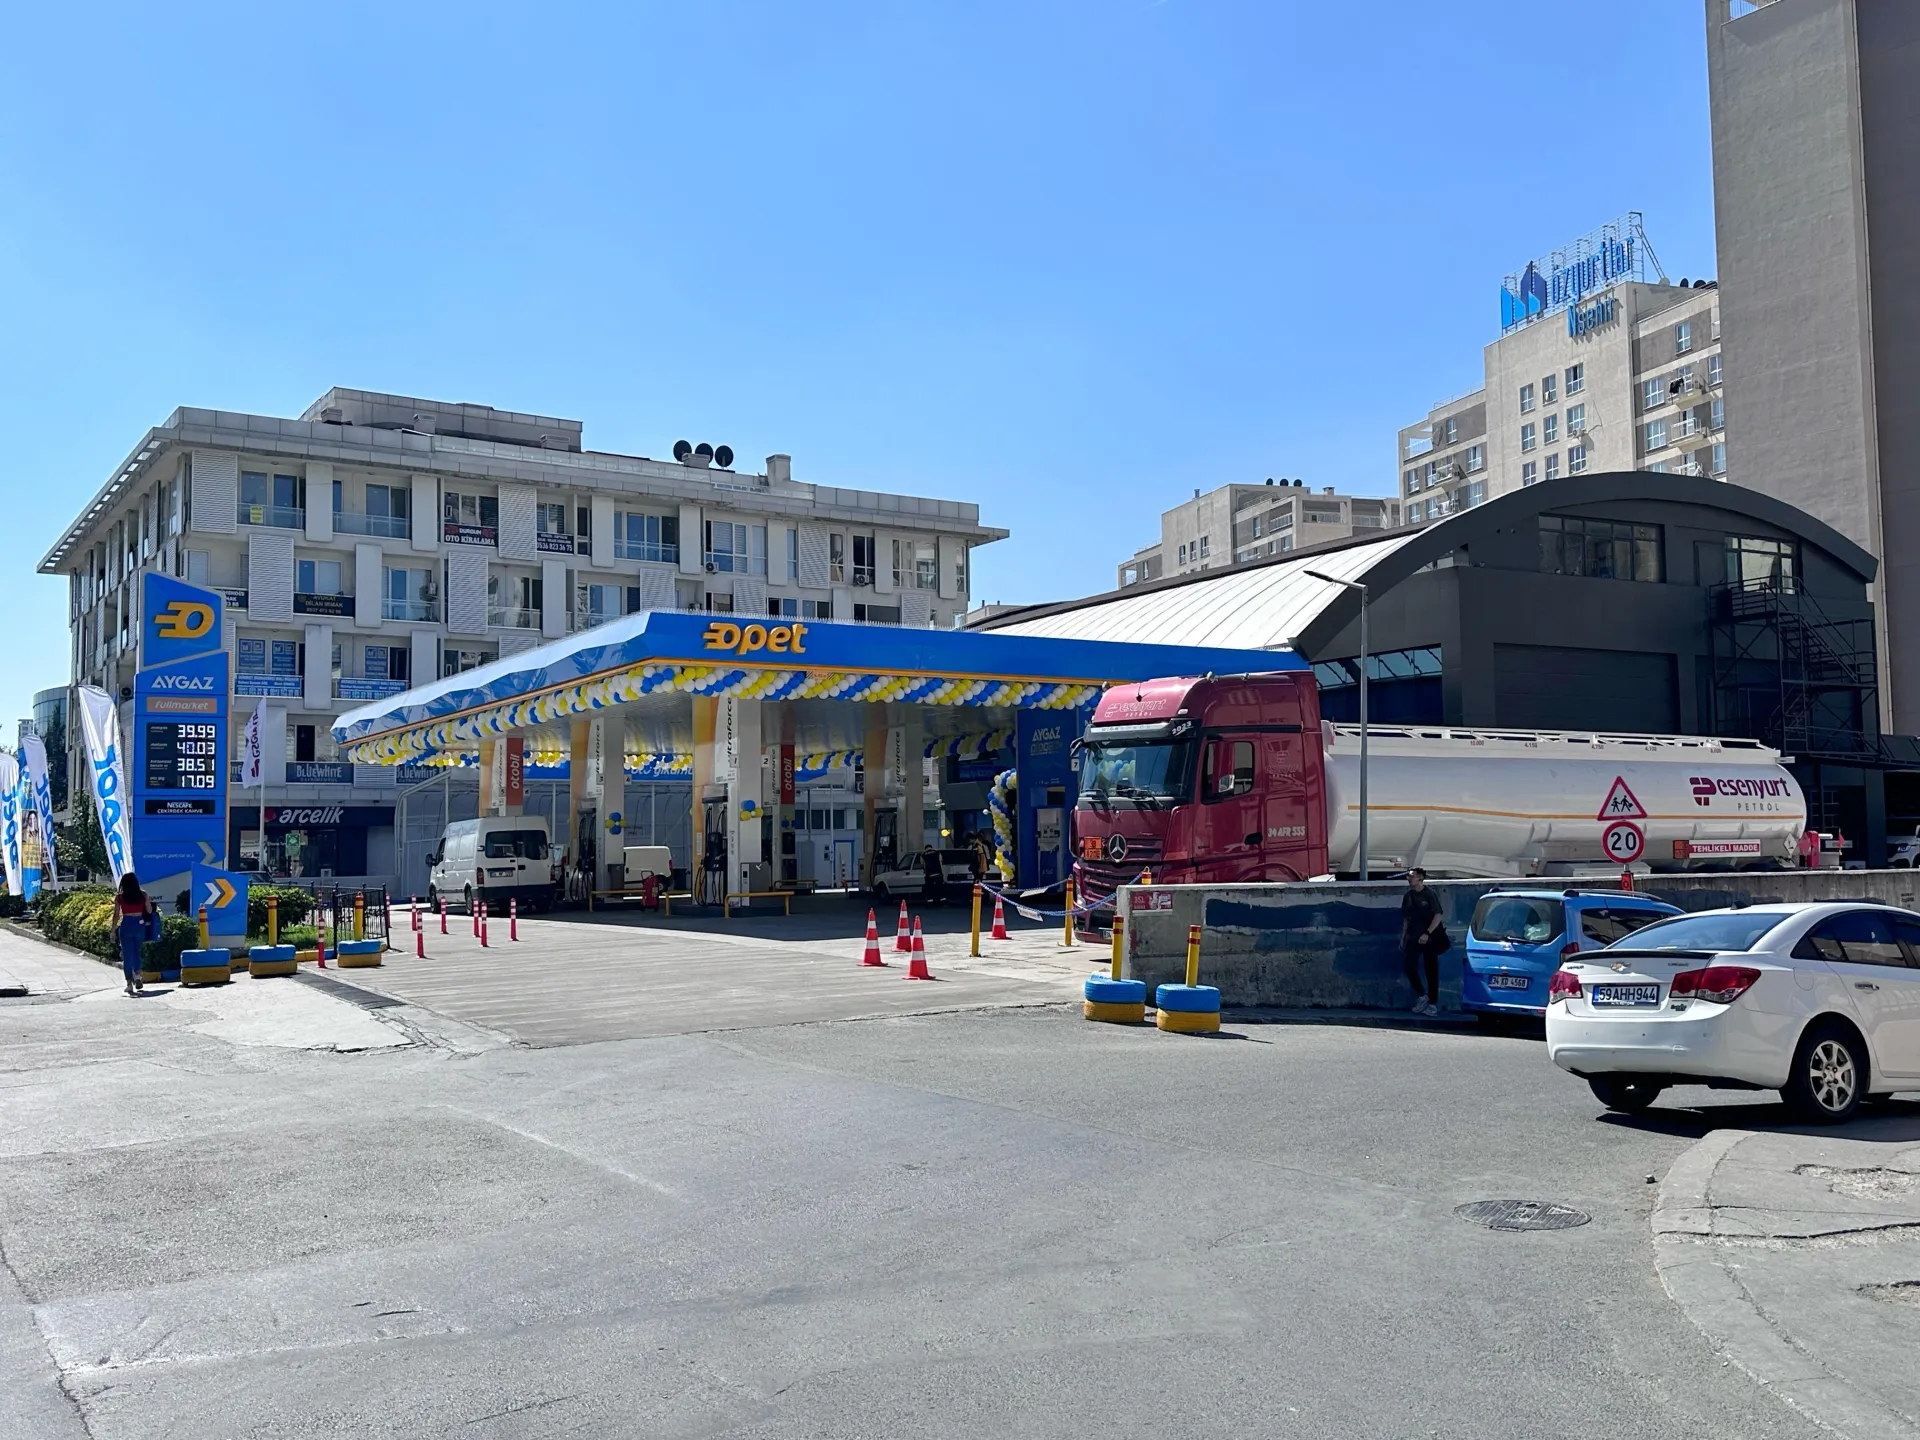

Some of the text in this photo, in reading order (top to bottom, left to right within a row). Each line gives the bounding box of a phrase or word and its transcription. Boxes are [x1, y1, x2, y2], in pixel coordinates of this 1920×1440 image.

[445, 534, 495, 546] OTO KİRALAMA
[703, 622, 808, 655] opet
[151, 675, 214, 690] AYGAZ
[155, 700, 209, 710] fullmarket
[177, 724, 216, 738] 39.99
[1032, 726, 1061, 741] AYGAZ
[1171, 720, 1192, 735] 2023
[176, 741, 215, 755] 40.03
[177, 758, 215, 771] 38.51
[296, 764, 342, 778] BLUEWHITE
[510, 753, 520, 789] otobil
[181, 775, 215, 788] 17.09
[783, 758, 792, 791] otobil
[1716, 777, 1791, 799] esenyurt
[1738, 803, 1779, 811] PETROL
[1610, 831, 1637, 851] 20
[1692, 843, 1732, 852] TEHLİKELİ
[1733, 844, 1758, 852] MADDE
[1600, 987, 1656, 1001] 59AHH944
